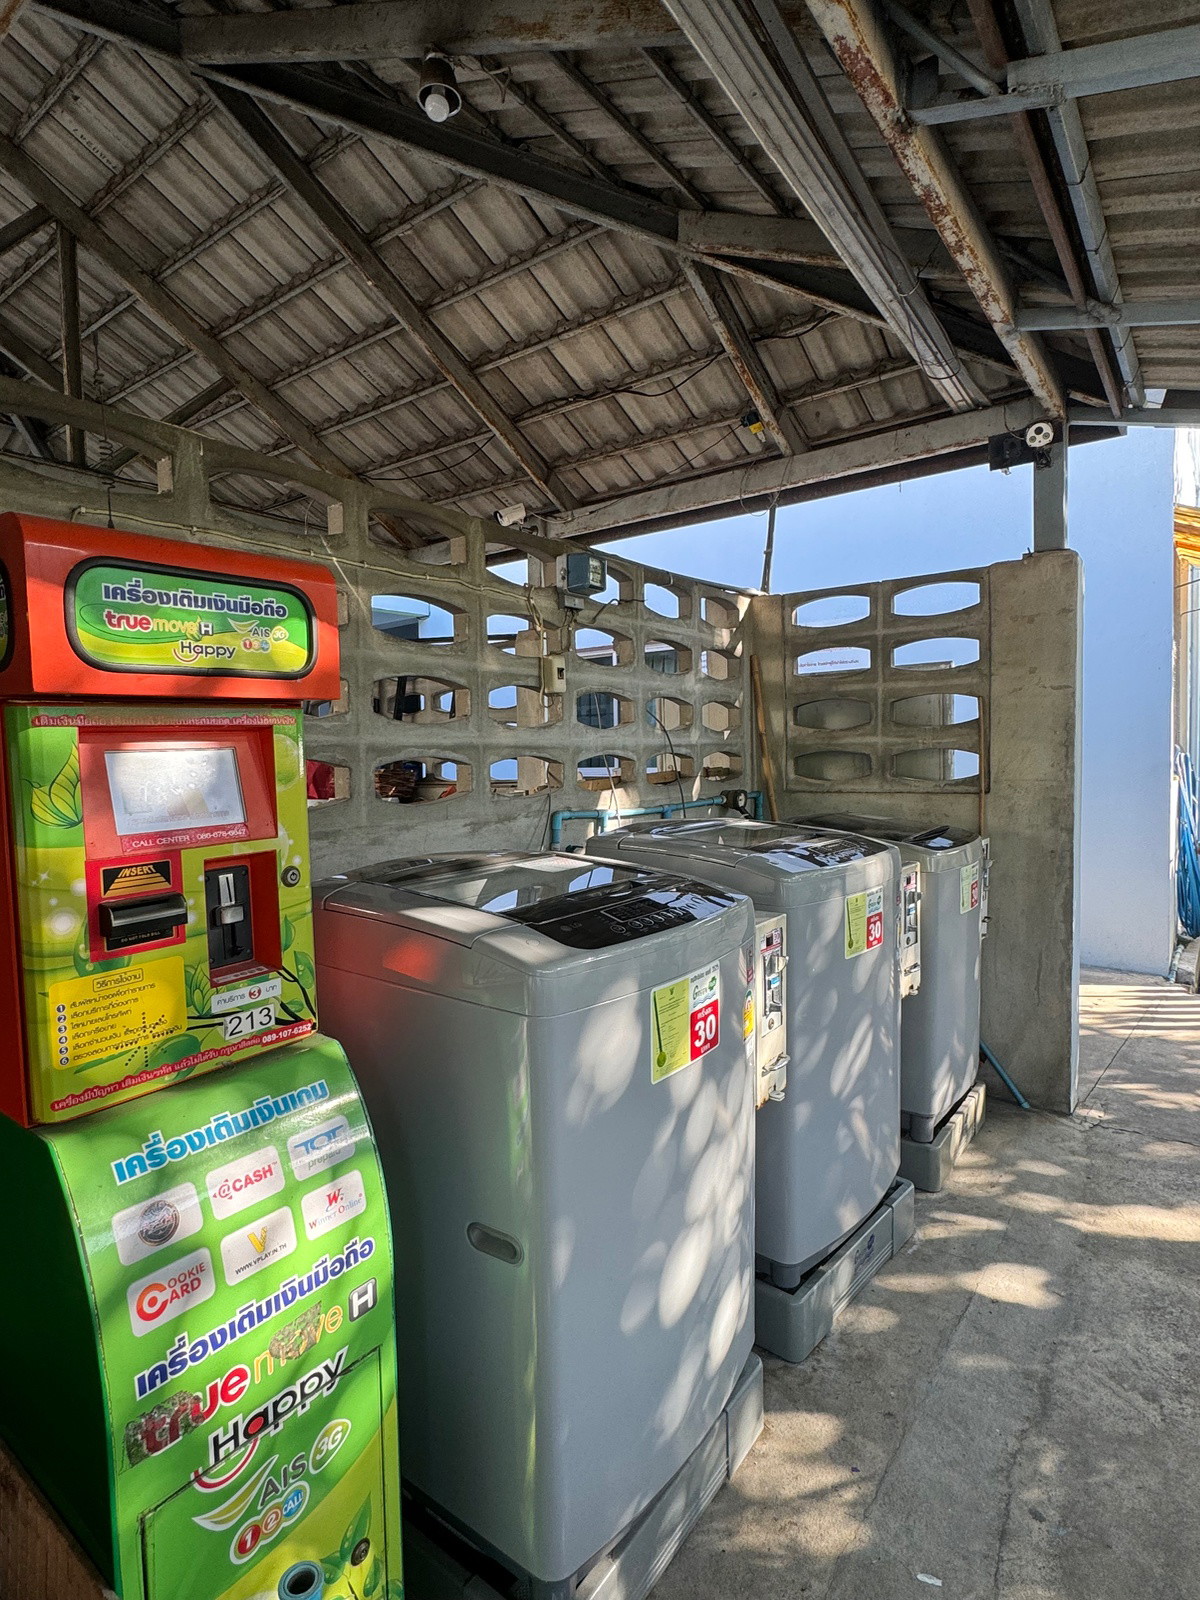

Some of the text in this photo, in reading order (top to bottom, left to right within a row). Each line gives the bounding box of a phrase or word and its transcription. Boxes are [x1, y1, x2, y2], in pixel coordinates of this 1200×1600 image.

[103, 578, 288, 618] เครื่องเติมเงินมือถือ
[251, 627, 272, 638] AIS
[180, 640, 236, 660] Happy
[131, 837, 156, 849] CALL
[156, 835, 191, 846] CENTER
[117, 864, 157, 878] INSERT
[868, 920, 881, 942] 30
[249, 987, 260, 999] 3
[265, 983, 278, 993] บาท
[228, 1006, 272, 1037] 213
[261, 1022, 312, 1044] 089-107-6252
[693, 1013, 717, 1048] 30
[113, 1081, 328, 1184] เครื่องเติมเงินเกม
[136, 1239, 374, 1398] เครื่องเติมเงินมือถือ
[211, 1350, 345, 1463] Happy
[260, 1425, 343, 1507] AIS 3G
